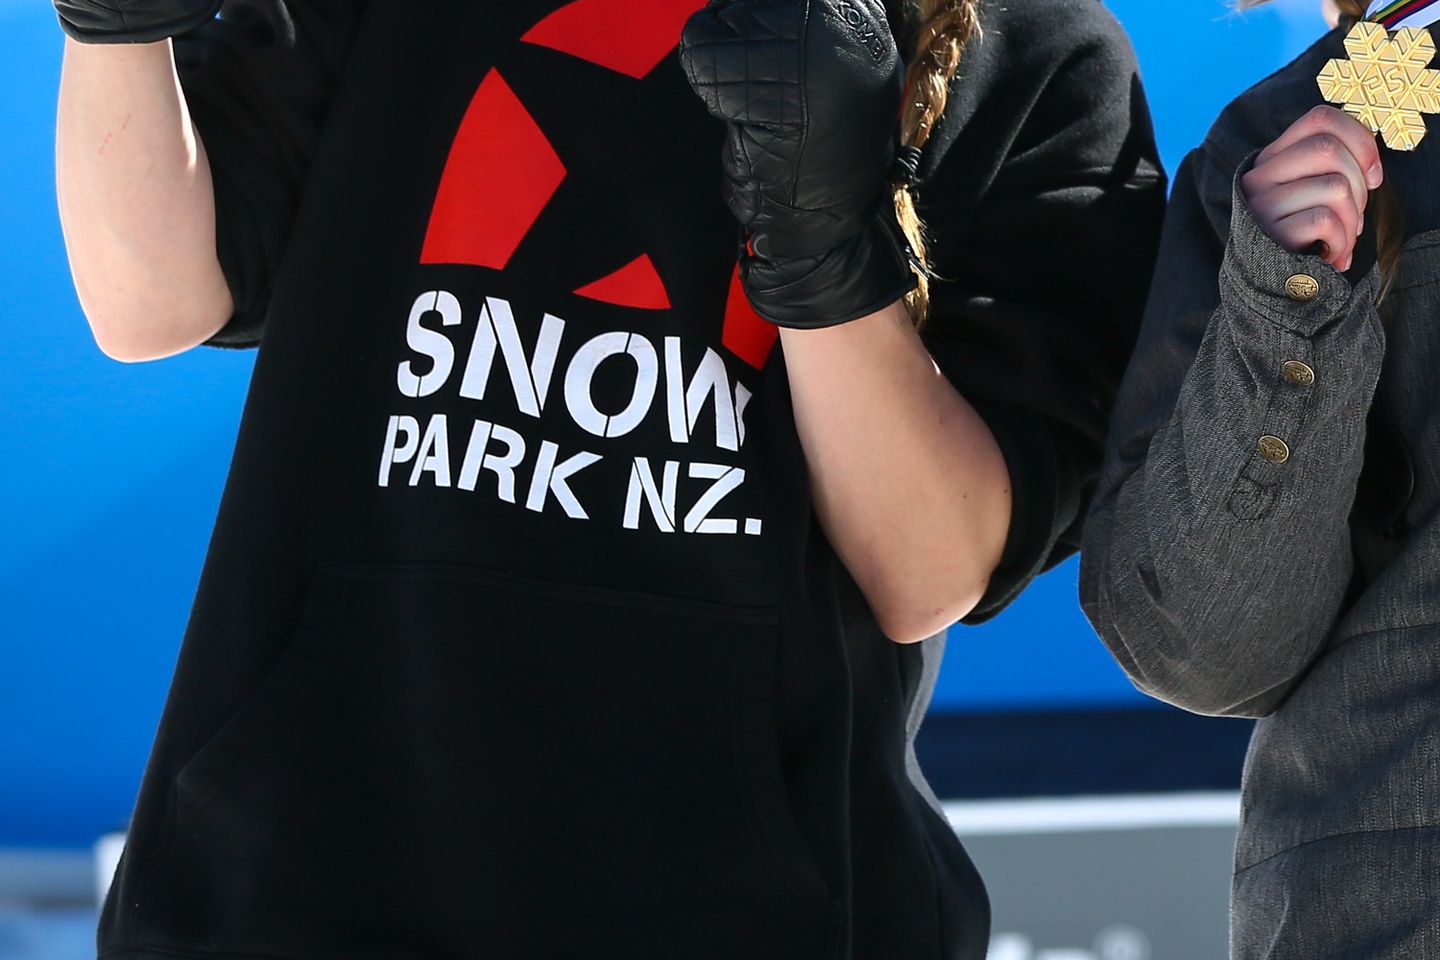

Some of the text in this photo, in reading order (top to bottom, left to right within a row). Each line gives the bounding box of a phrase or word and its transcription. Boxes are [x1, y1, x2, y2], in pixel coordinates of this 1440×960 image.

[1362, 65, 1406, 106] FIS
[396, 290, 752, 452] SNOW
[378, 413, 762, 535] PARK NZ.
